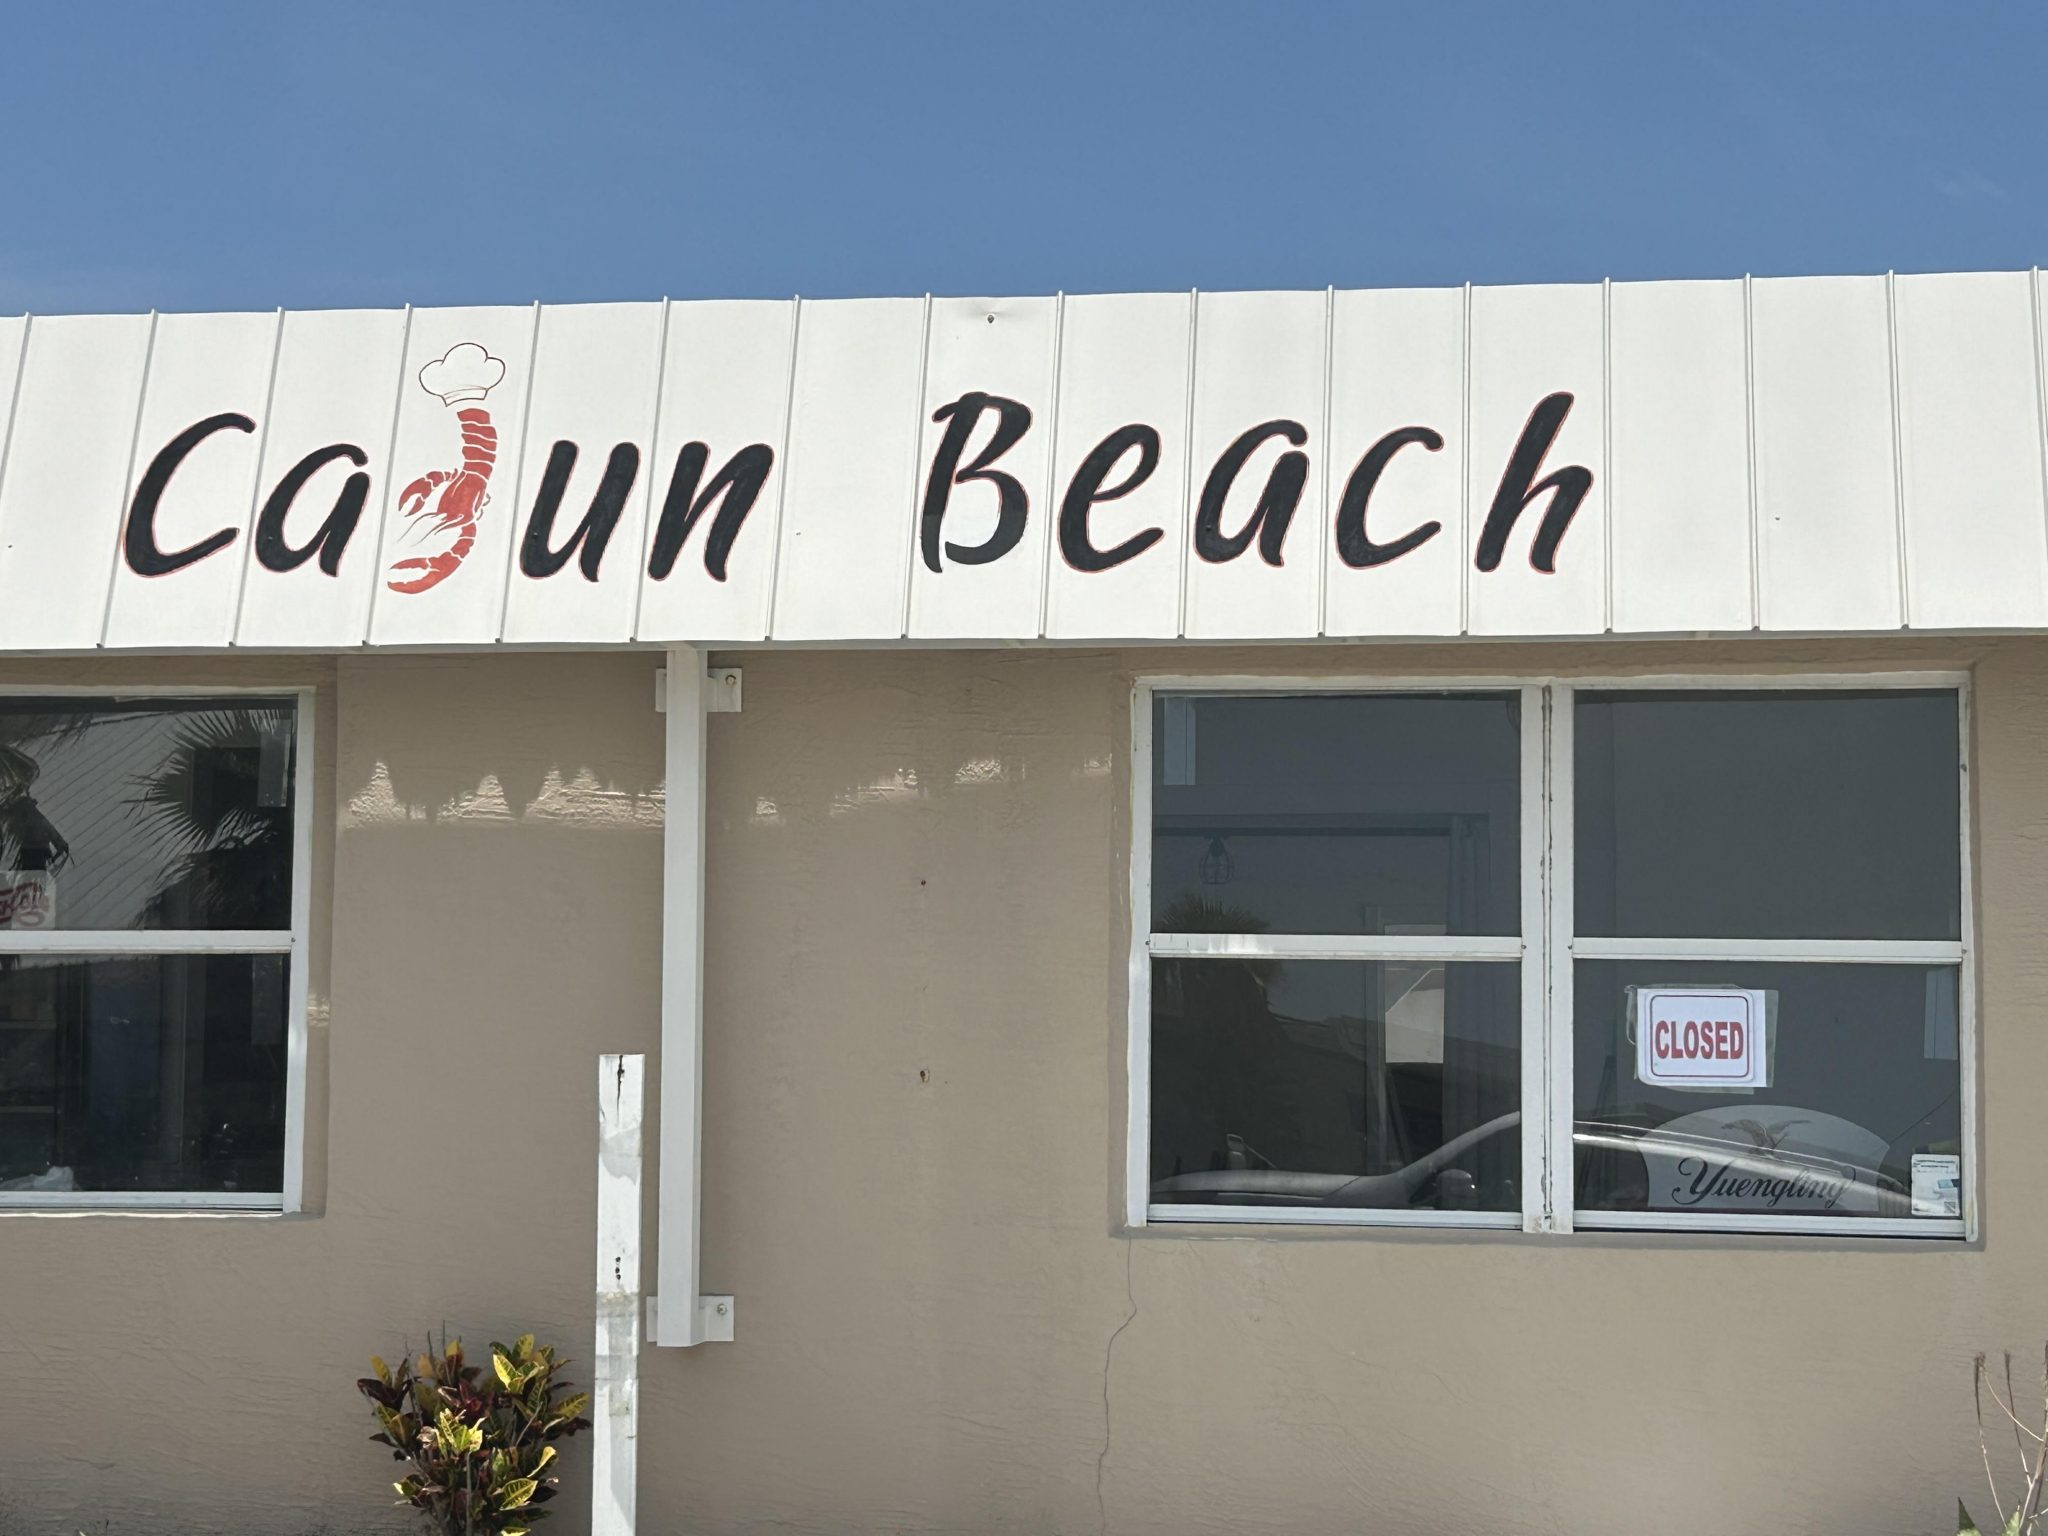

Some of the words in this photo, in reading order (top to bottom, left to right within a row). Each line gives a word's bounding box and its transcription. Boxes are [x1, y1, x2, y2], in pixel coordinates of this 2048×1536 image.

[122, 406, 775, 594] Cajun
[920, 391, 1595, 575] Beach
[1655, 1020, 1744, 1060] CLOSED
[1671, 1157, 1857, 1209] Yuengling
